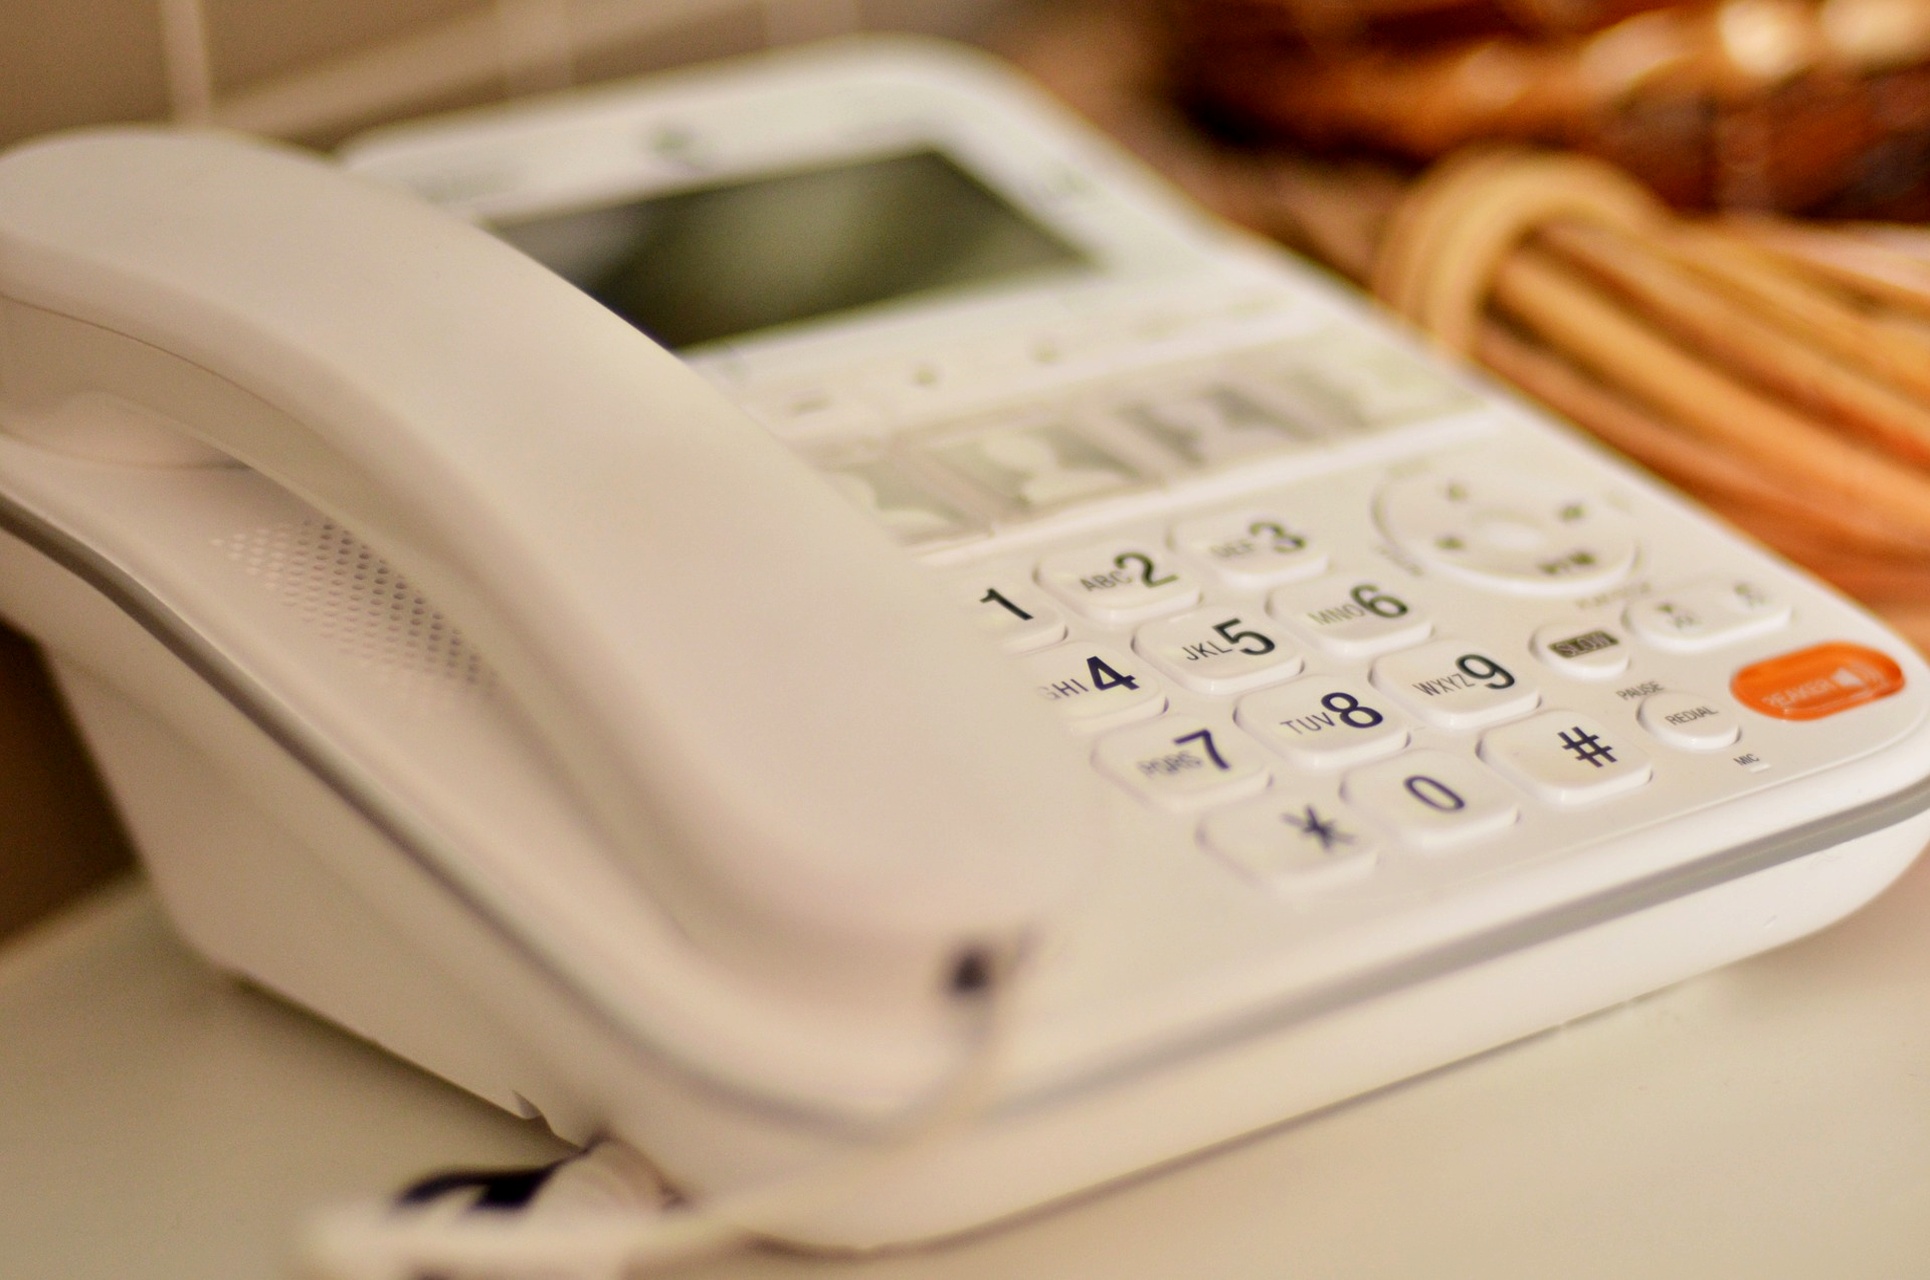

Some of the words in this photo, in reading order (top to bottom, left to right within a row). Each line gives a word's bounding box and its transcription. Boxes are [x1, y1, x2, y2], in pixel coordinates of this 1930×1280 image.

[1250, 521, 1307, 553] 3
[1080, 571, 1132, 592] ABC
[1114, 552, 1179, 588] 2
[980, 588, 1033, 621] 1
[1307, 603, 1366, 626] MNO
[1350, 583, 1409, 618] 6
[1182, 640, 1233, 661] JKL
[1212, 618, 1275, 656] 5
[1086, 656, 1140, 690] 4
[1412, 674, 1476, 696] WXYZ
[1455, 654, 1515, 690] 9
[1616, 681, 1665, 700] PAUSE
[1280, 712, 1336, 735] TUV
[1321, 692, 1384, 729] 8
[1665, 706, 1719, 725] REDIAL
[1173, 729, 1231, 770] 7
[1733, 753, 1760, 766] MIC
[1404, 775, 1466, 813] 0
